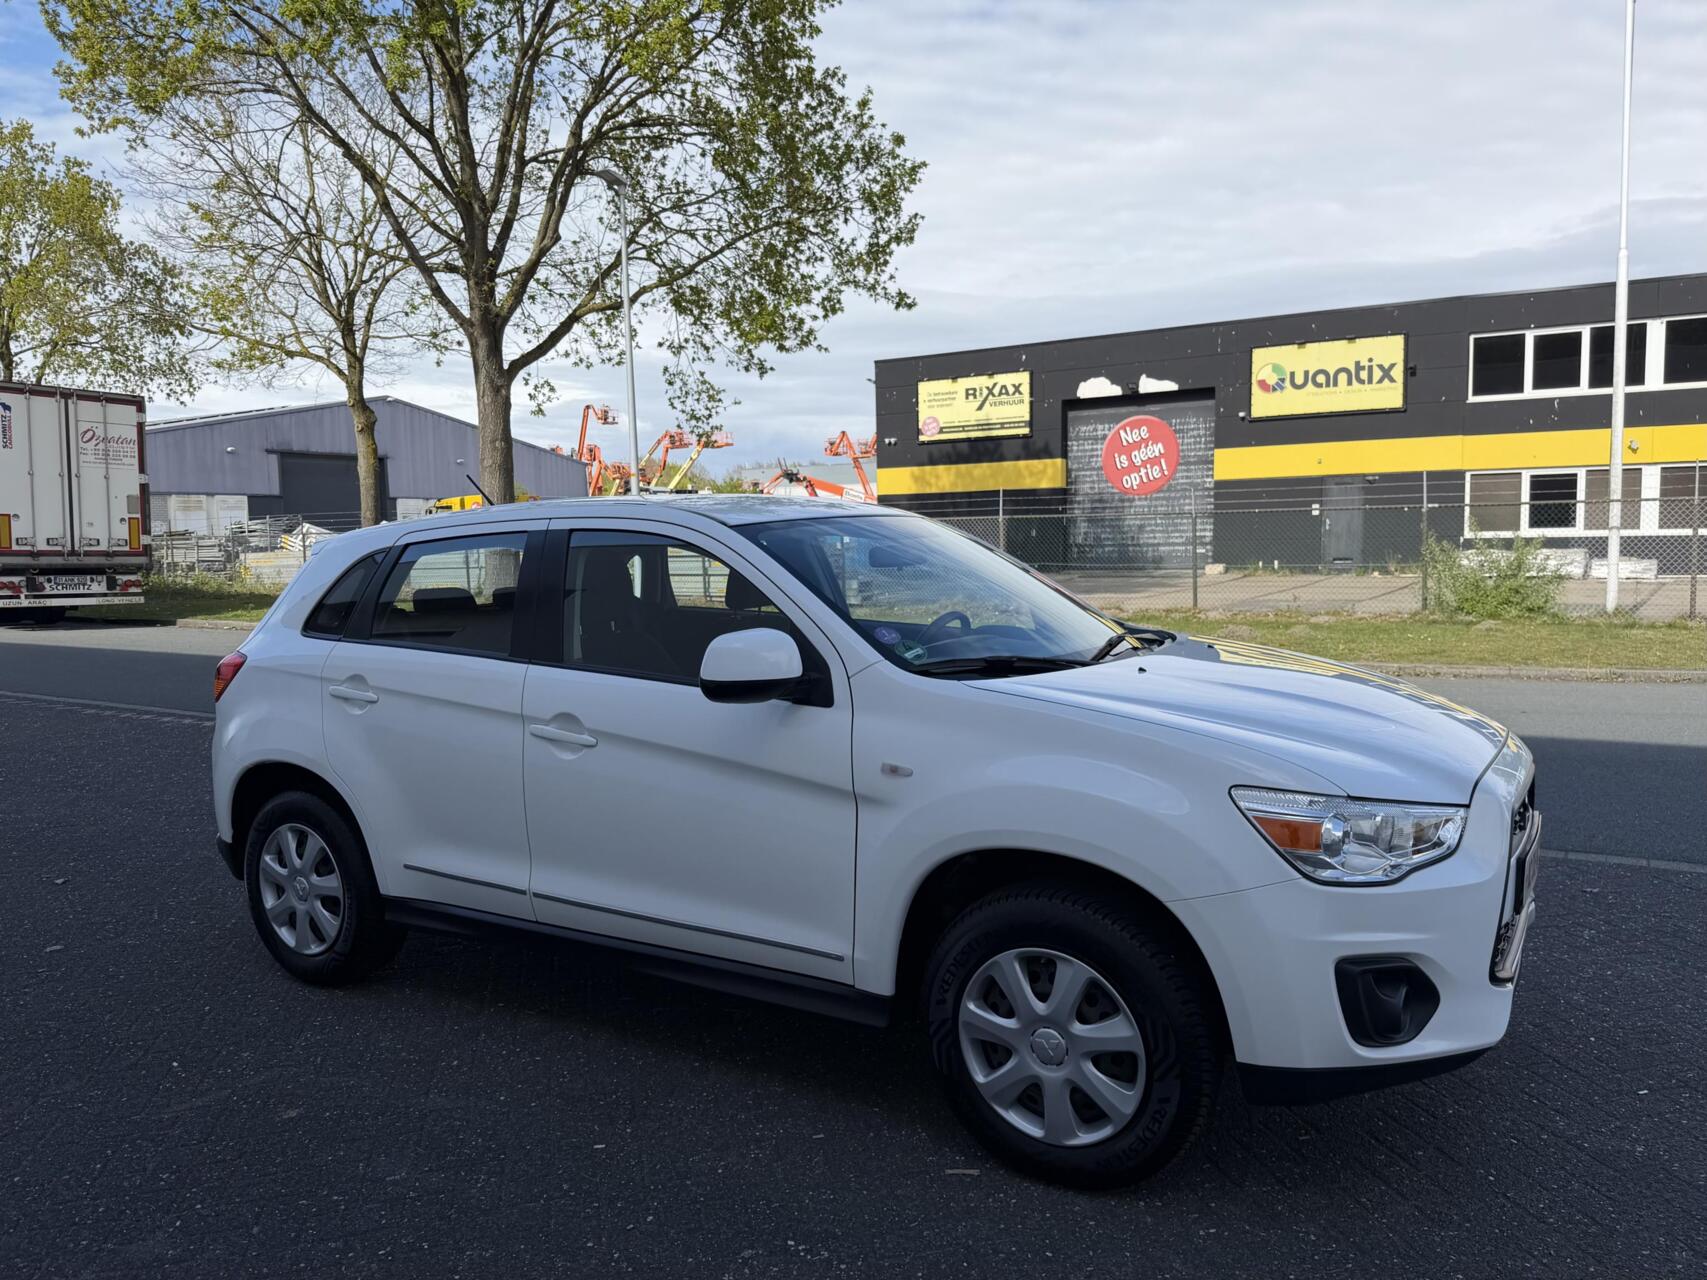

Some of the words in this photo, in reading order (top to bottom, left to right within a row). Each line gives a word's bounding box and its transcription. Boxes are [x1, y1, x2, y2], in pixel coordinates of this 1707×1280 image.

[989, 399, 1025, 407] VERHUUR
[1119, 425, 1149, 446] Nee
[1114, 452, 1129, 470] is
[1131, 440, 1165, 467] géén
[49, 583, 93, 592] SCHMITZ
